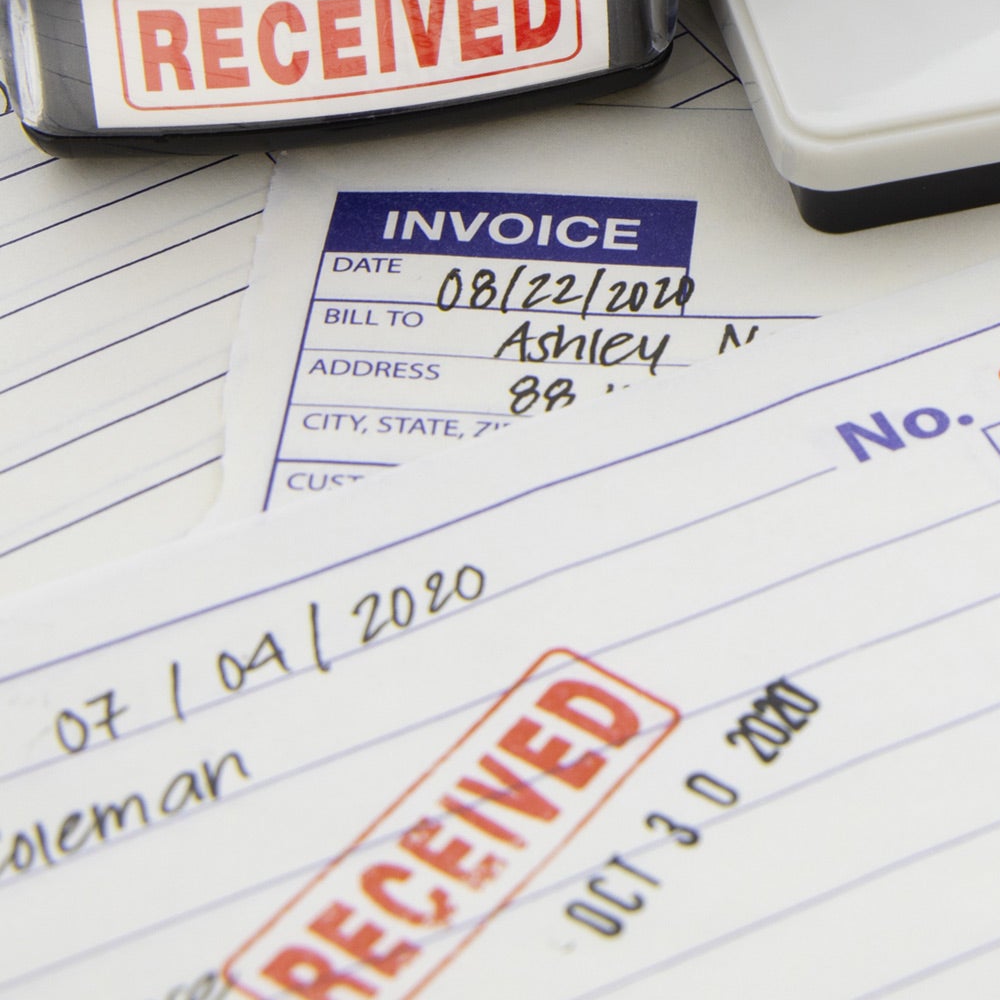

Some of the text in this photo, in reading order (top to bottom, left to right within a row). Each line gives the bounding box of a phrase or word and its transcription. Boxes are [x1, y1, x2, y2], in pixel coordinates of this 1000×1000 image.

[381, 209, 642, 252] INVOICE
[332, 256, 403, 275] DATE
[437, 265, 695, 320] 08/22/2020
[323, 307, 424, 329] BILL TO
[309, 358, 441, 381] ADDRESS
[494, 320, 671, 376] Ashley
[302, 412, 368, 435] CITY,
[376, 415, 465, 440] STATE,
[836, 405, 975, 463] No.
[0, 751, 250, 876] oleman
[565, 853, 662, 940] OCT
[725, 676, 821, 764] 2020
[259, 679, 641, 1000] RECEIVED
